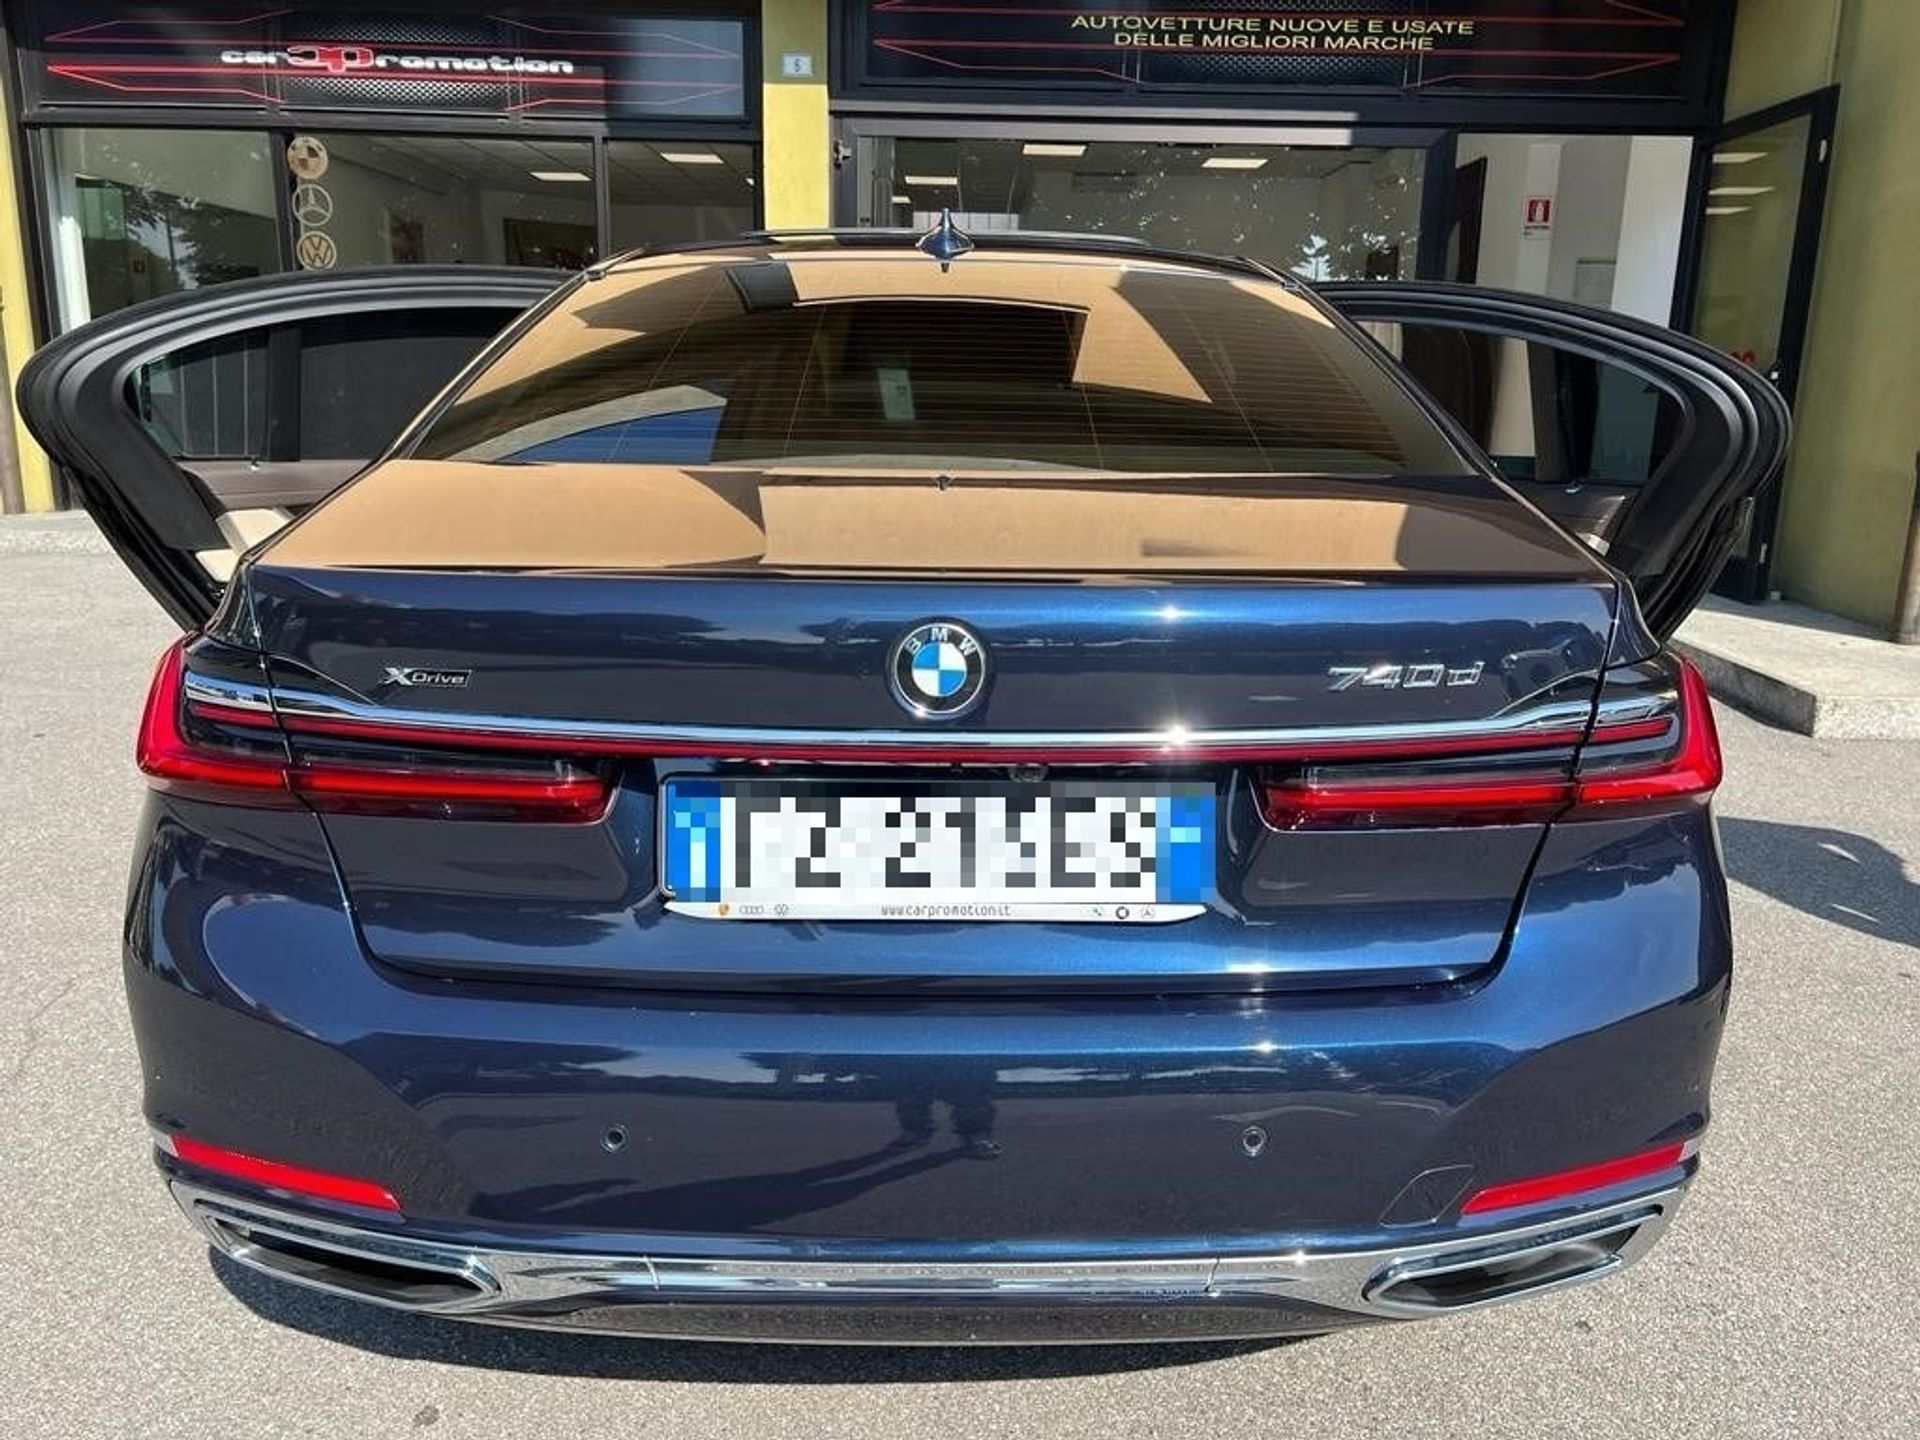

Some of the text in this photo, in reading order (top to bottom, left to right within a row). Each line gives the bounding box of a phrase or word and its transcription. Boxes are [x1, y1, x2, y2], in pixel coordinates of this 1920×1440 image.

[1071, 16, 1474, 35] AUTOVETTURE NUOVE E USATE
[1114, 32, 1434, 50] DELLE MIGLIORI MARCHE
[904, 627, 978, 656] BMW
[1327, 661, 1485, 692] 740d
